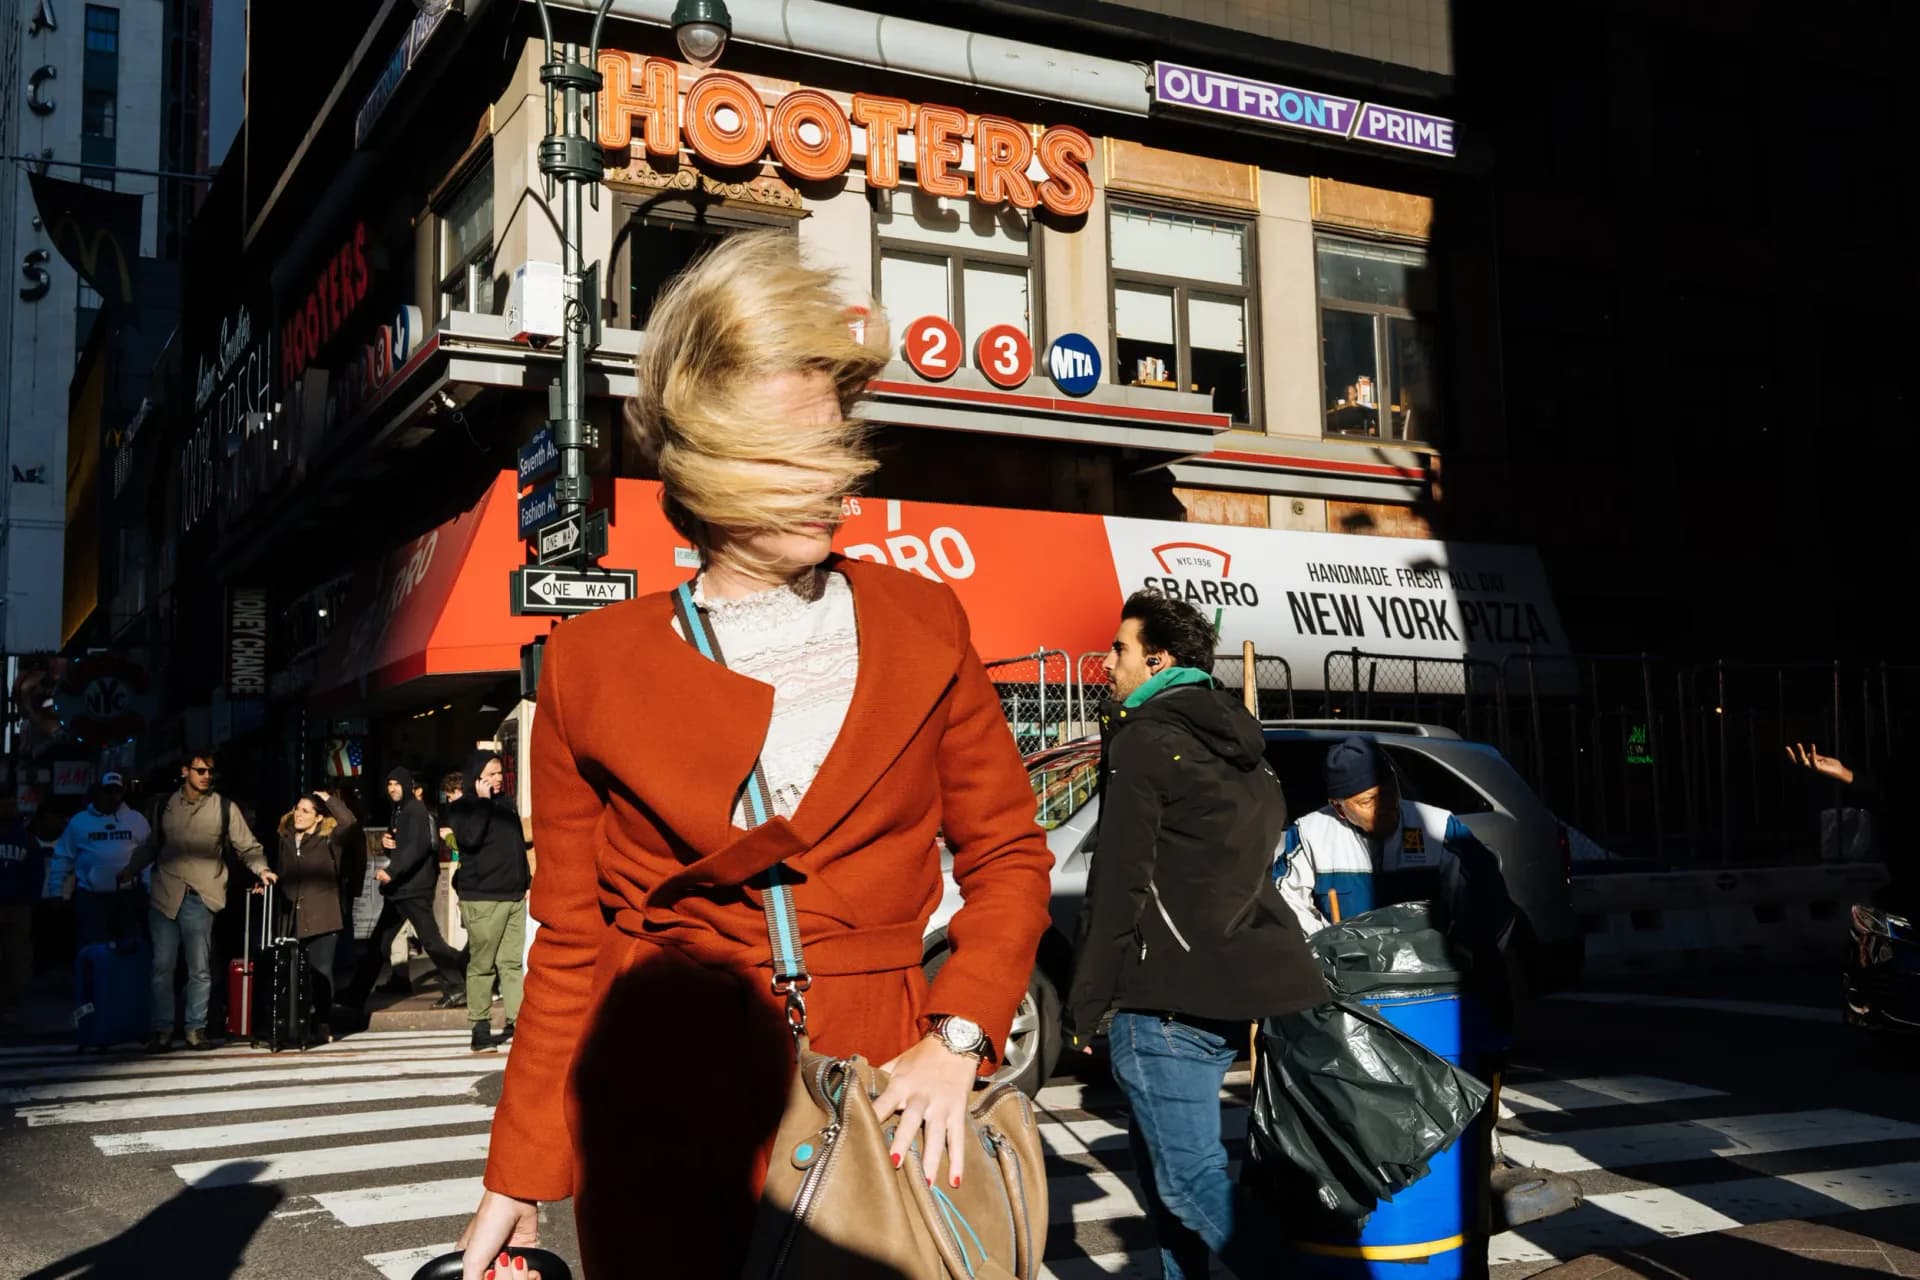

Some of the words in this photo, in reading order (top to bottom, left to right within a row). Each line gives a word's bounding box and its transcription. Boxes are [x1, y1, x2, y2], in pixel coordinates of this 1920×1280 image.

[1164, 69, 1347, 130] OUTFRONT
[1368, 110, 1455, 151] PRIME
[598, 48, 1095, 216] HOOTERS
[281, 219, 369, 391] HOOTERS
[920, 327, 948, 368] 2
[993, 335, 1020, 375] 3
[1050, 345, 1095, 381] MTA
[520, 443, 546, 478] Seventh
[521, 499, 547, 529] Fashion
[545, 533, 558, 550] ONE
[562, 526, 576, 543] WAY
[542, 582, 572, 597] ONE
[585, 583, 617, 598] WAY
[1306, 562, 1392, 587] HANDMADE
[1395, 567, 1443, 589] FRESH
[1448, 571, 1474, 591] ALL
[1481, 572, 1506, 593] DAY
[232, 586, 267, 637] MONEY
[1286, 591, 1365, 637] NEW
[1367, 595, 1460, 641] YORK
[1457, 599, 1552, 644] PIZZA
[232, 637, 265, 695] CHANGE
[109, 830, 132, 841] STATE
